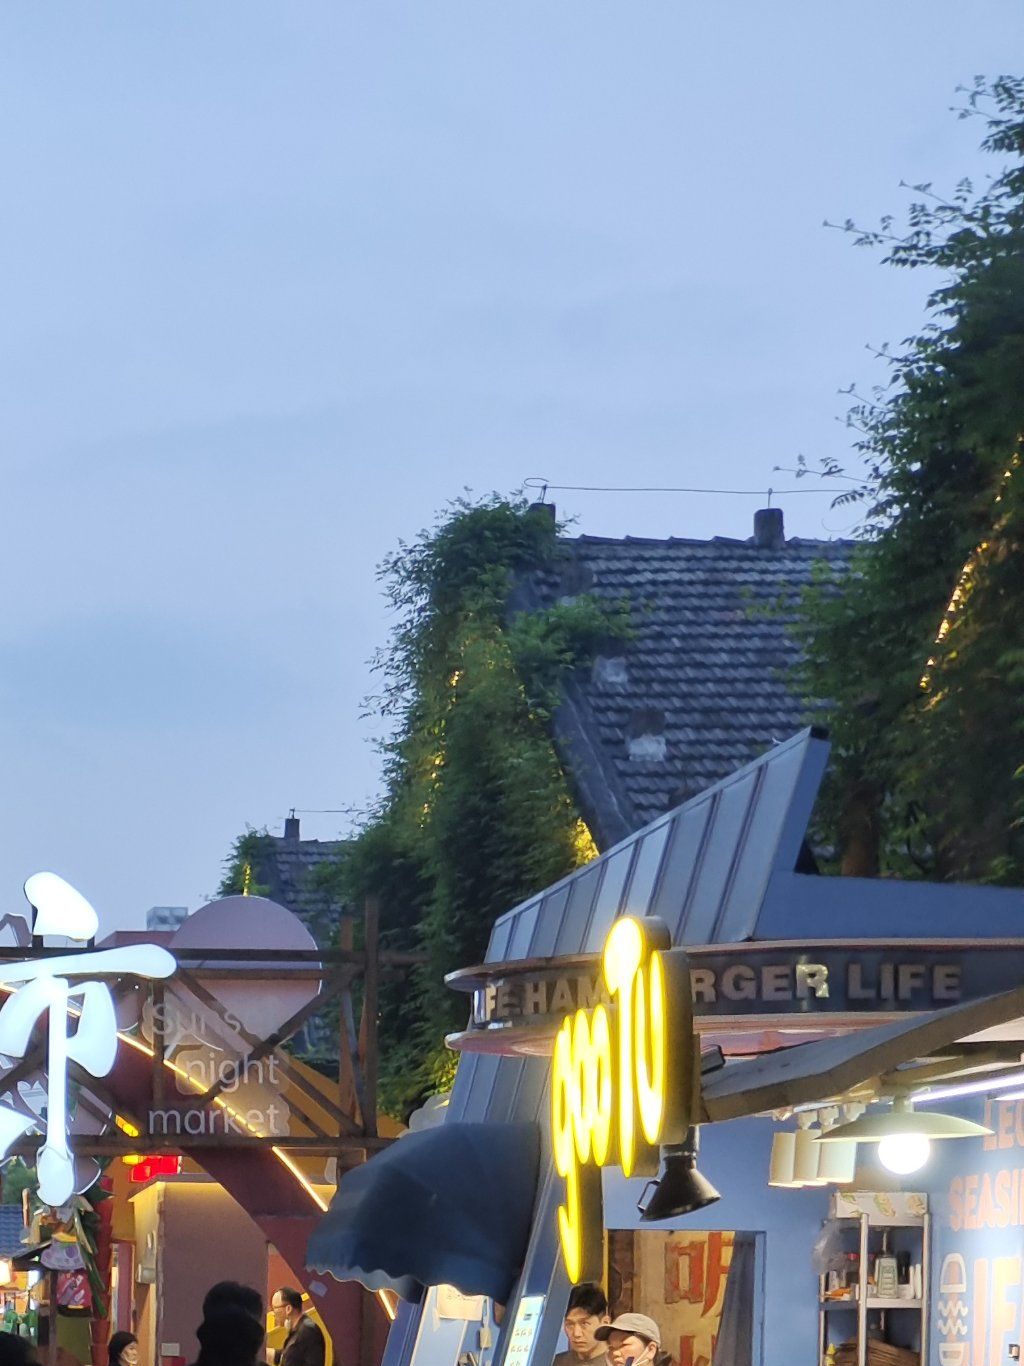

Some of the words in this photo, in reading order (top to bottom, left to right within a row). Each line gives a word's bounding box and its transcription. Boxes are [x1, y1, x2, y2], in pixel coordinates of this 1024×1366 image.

[527, 962, 830, 1015] HAMRGER
[848, 962, 962, 1001] LIFE
[186, 1052, 280, 1093] night
[149, 1104, 279, 1135] market
[949, 1168, 1024, 1231] SEASI
